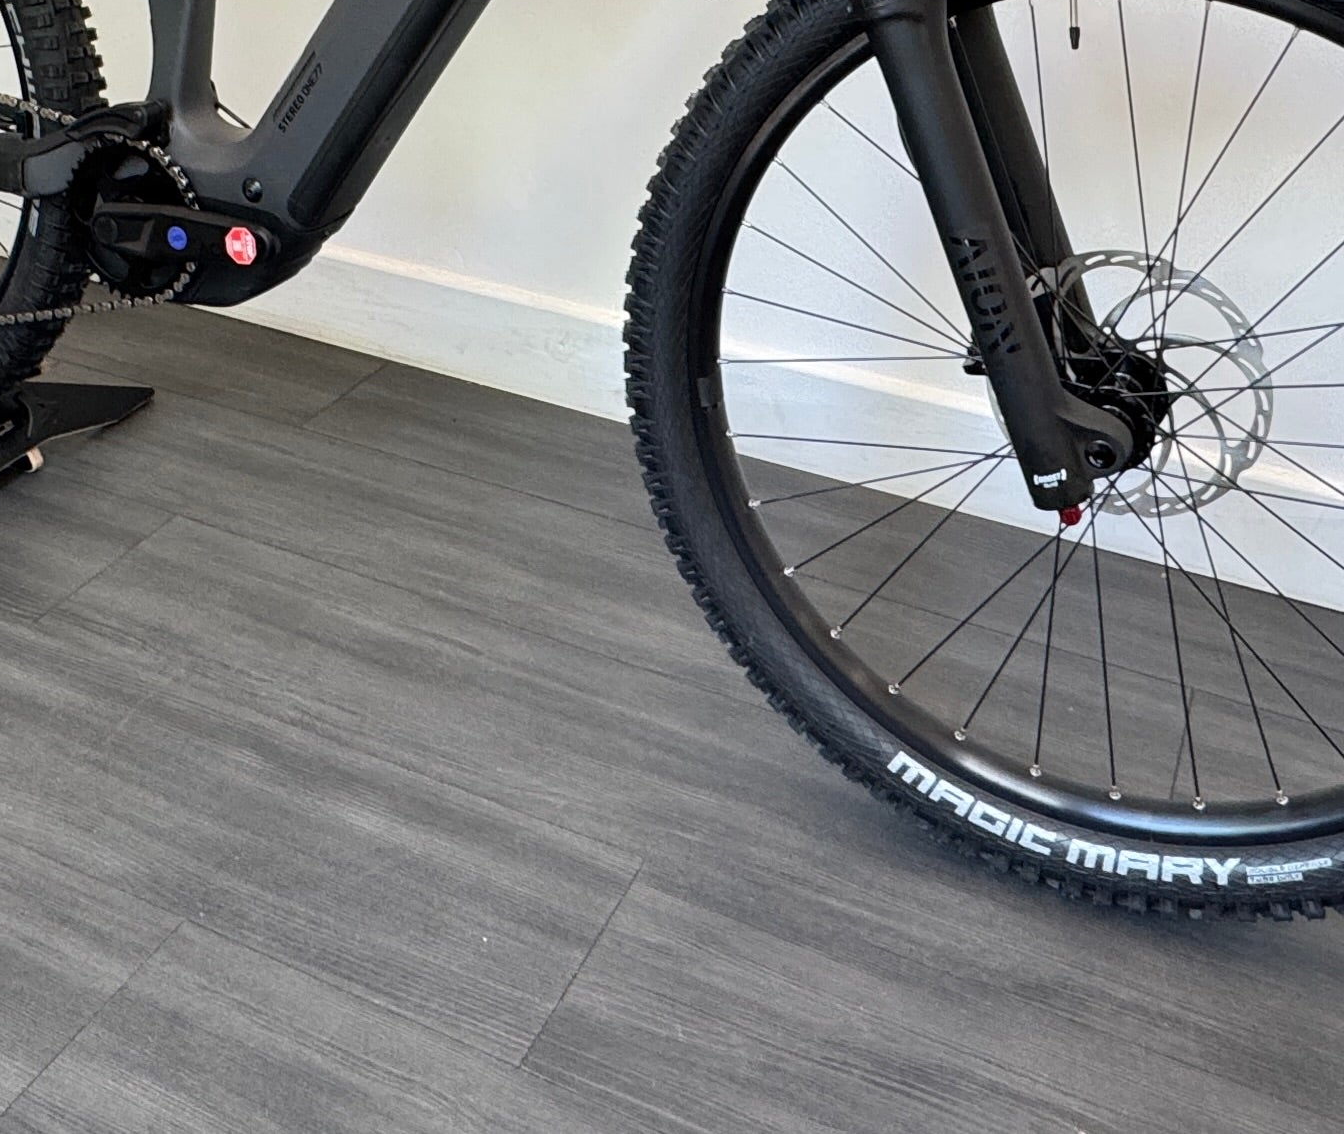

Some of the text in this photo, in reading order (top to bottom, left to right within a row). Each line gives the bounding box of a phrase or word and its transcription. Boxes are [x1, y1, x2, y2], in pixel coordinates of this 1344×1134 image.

[278, 94, 305, 133] STEREO
[886, 750, 1241, 886] MAGIC MARY
